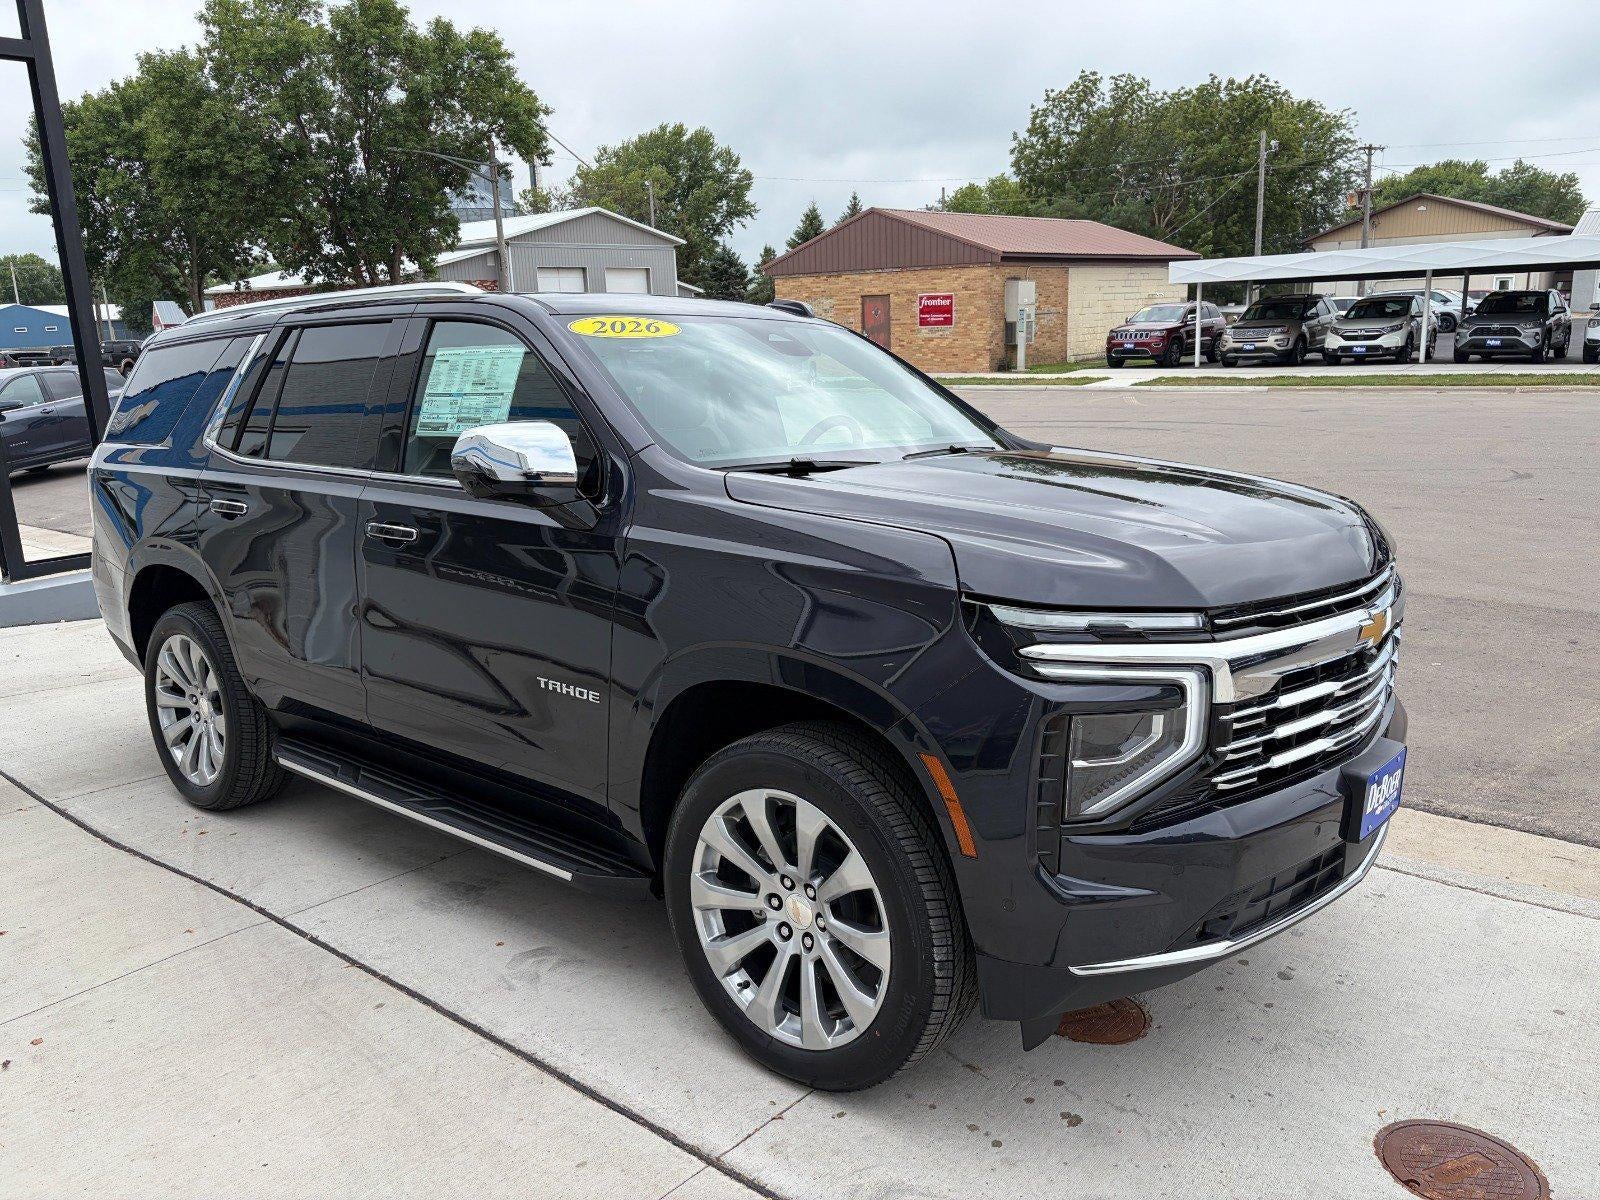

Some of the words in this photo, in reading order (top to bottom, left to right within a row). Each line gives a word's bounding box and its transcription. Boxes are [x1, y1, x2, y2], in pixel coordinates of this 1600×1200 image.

[919, 297, 951, 308] frontier
[592, 320, 661, 334] 2026
[536, 676, 600, 703] TAHOE
